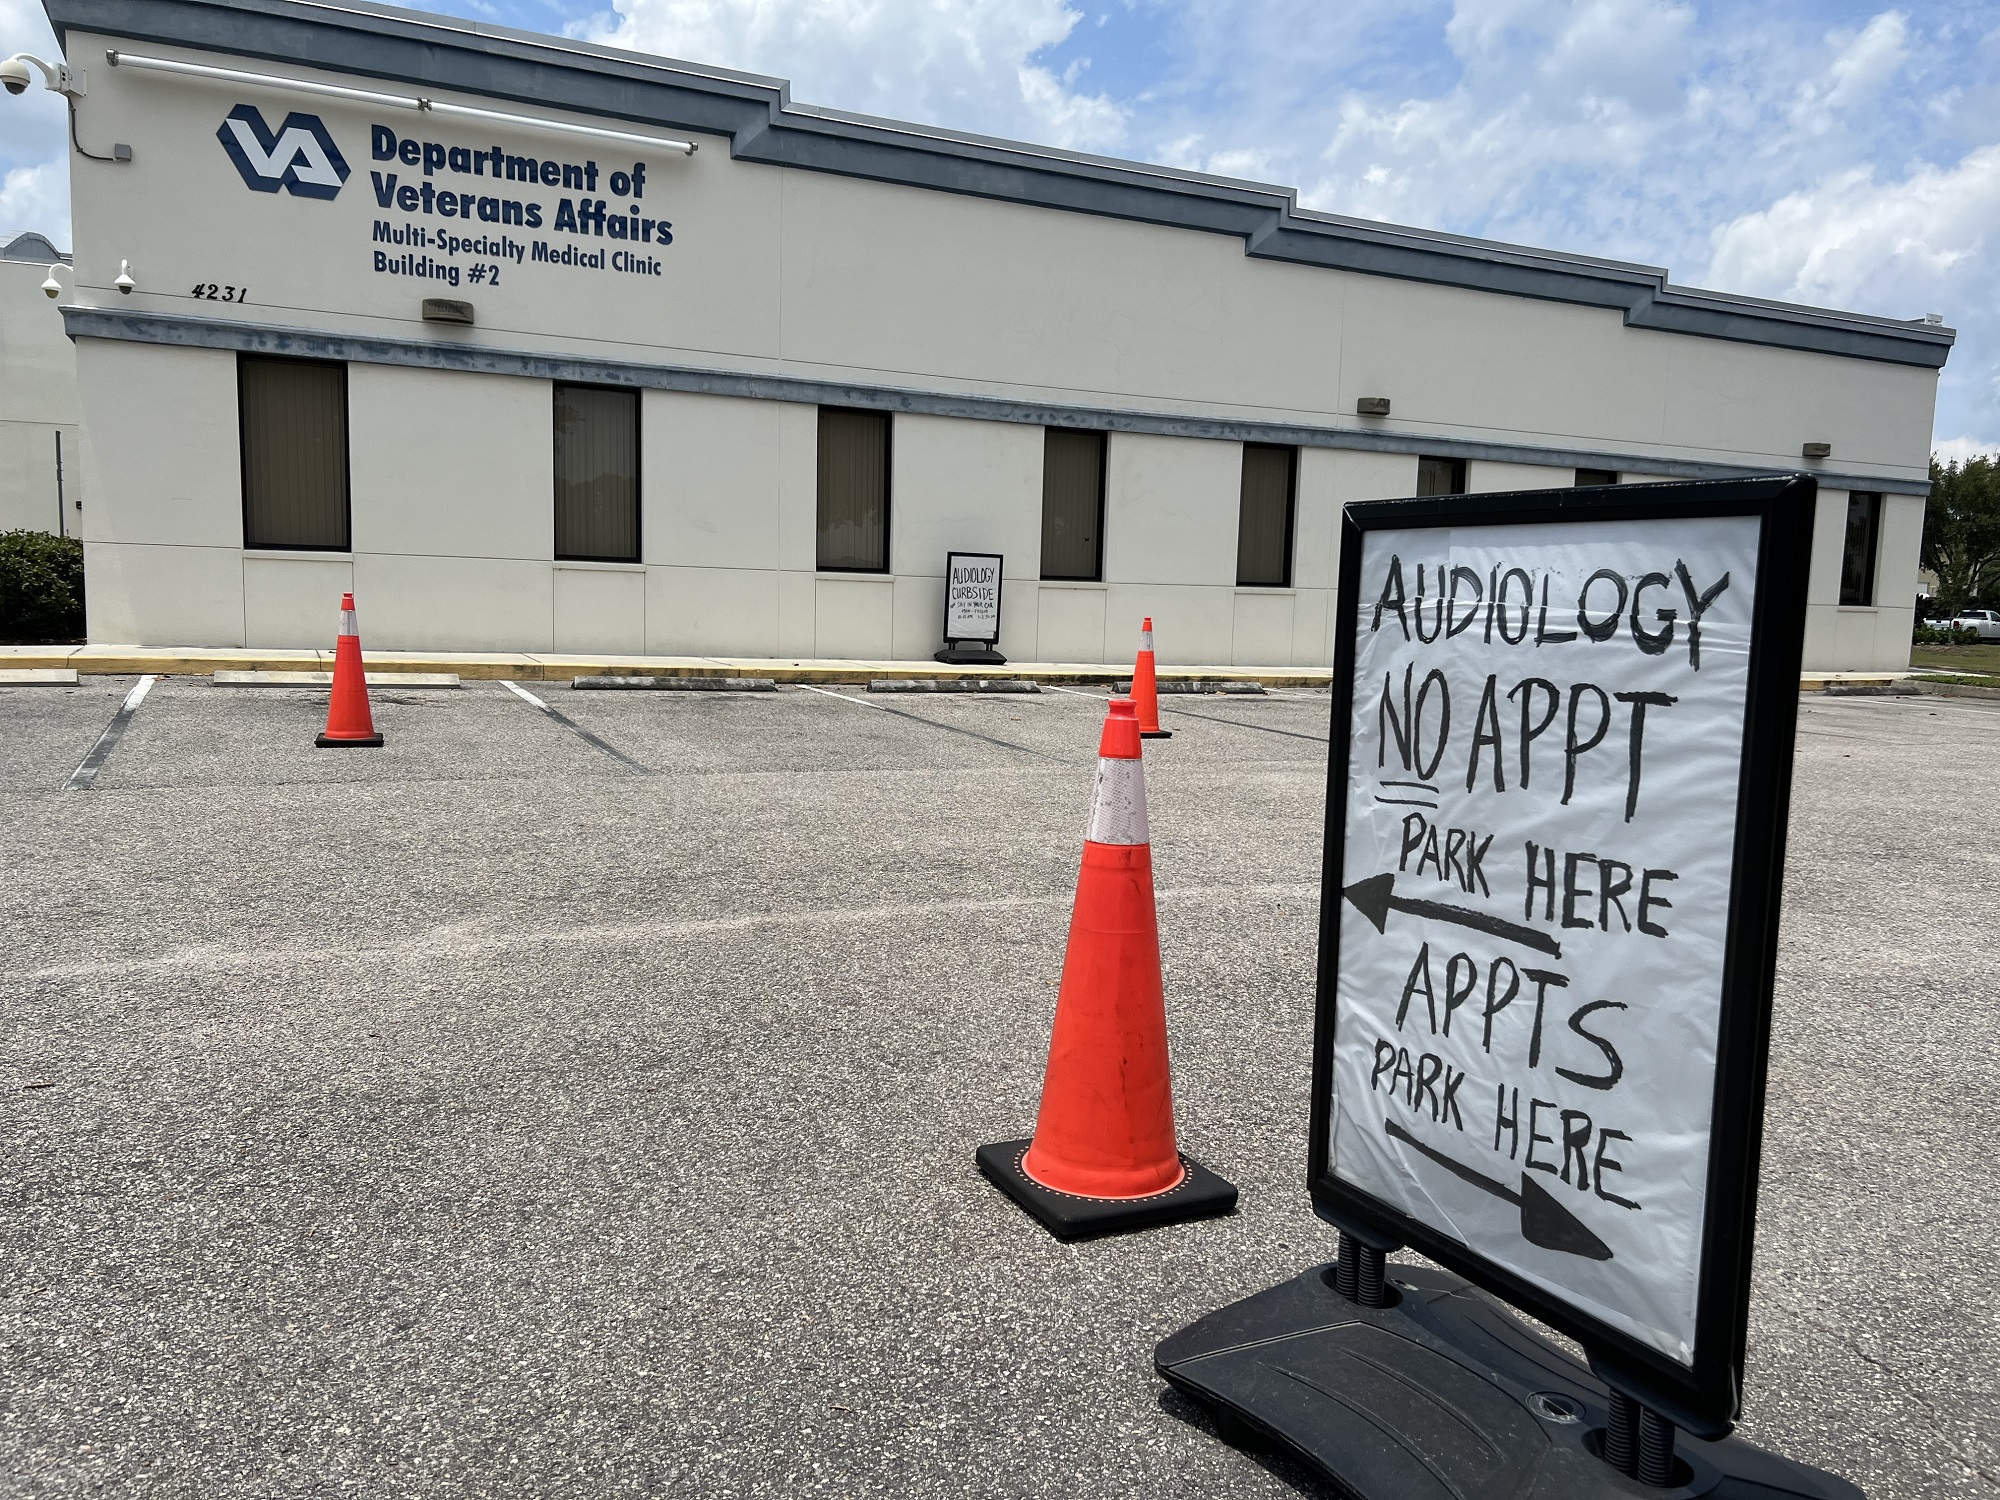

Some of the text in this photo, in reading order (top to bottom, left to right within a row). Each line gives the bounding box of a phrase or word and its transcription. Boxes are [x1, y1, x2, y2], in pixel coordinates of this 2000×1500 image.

[224, 116, 344, 188] VA
[370, 123, 646, 199] Department of
[369, 170, 674, 246] Veterans Affairs
[372, 219, 662, 277] Multi-Specialty Medical Clinic
[373, 250, 500, 287] Building #2
[190, 282, 248, 304] 4231
[952, 567, 995, 585] AUDIOLOGY
[952, 586, 994, 601] CURBSIDE
[1370, 553, 1730, 672] AUDIOLOGY
[1378, 661, 1679, 824] NO APPT
[1399, 811, 1680, 939] PARK HERE
[1394, 941, 1629, 1091] APPTS
[1370, 1037, 1642, 1210] PARK HERE
